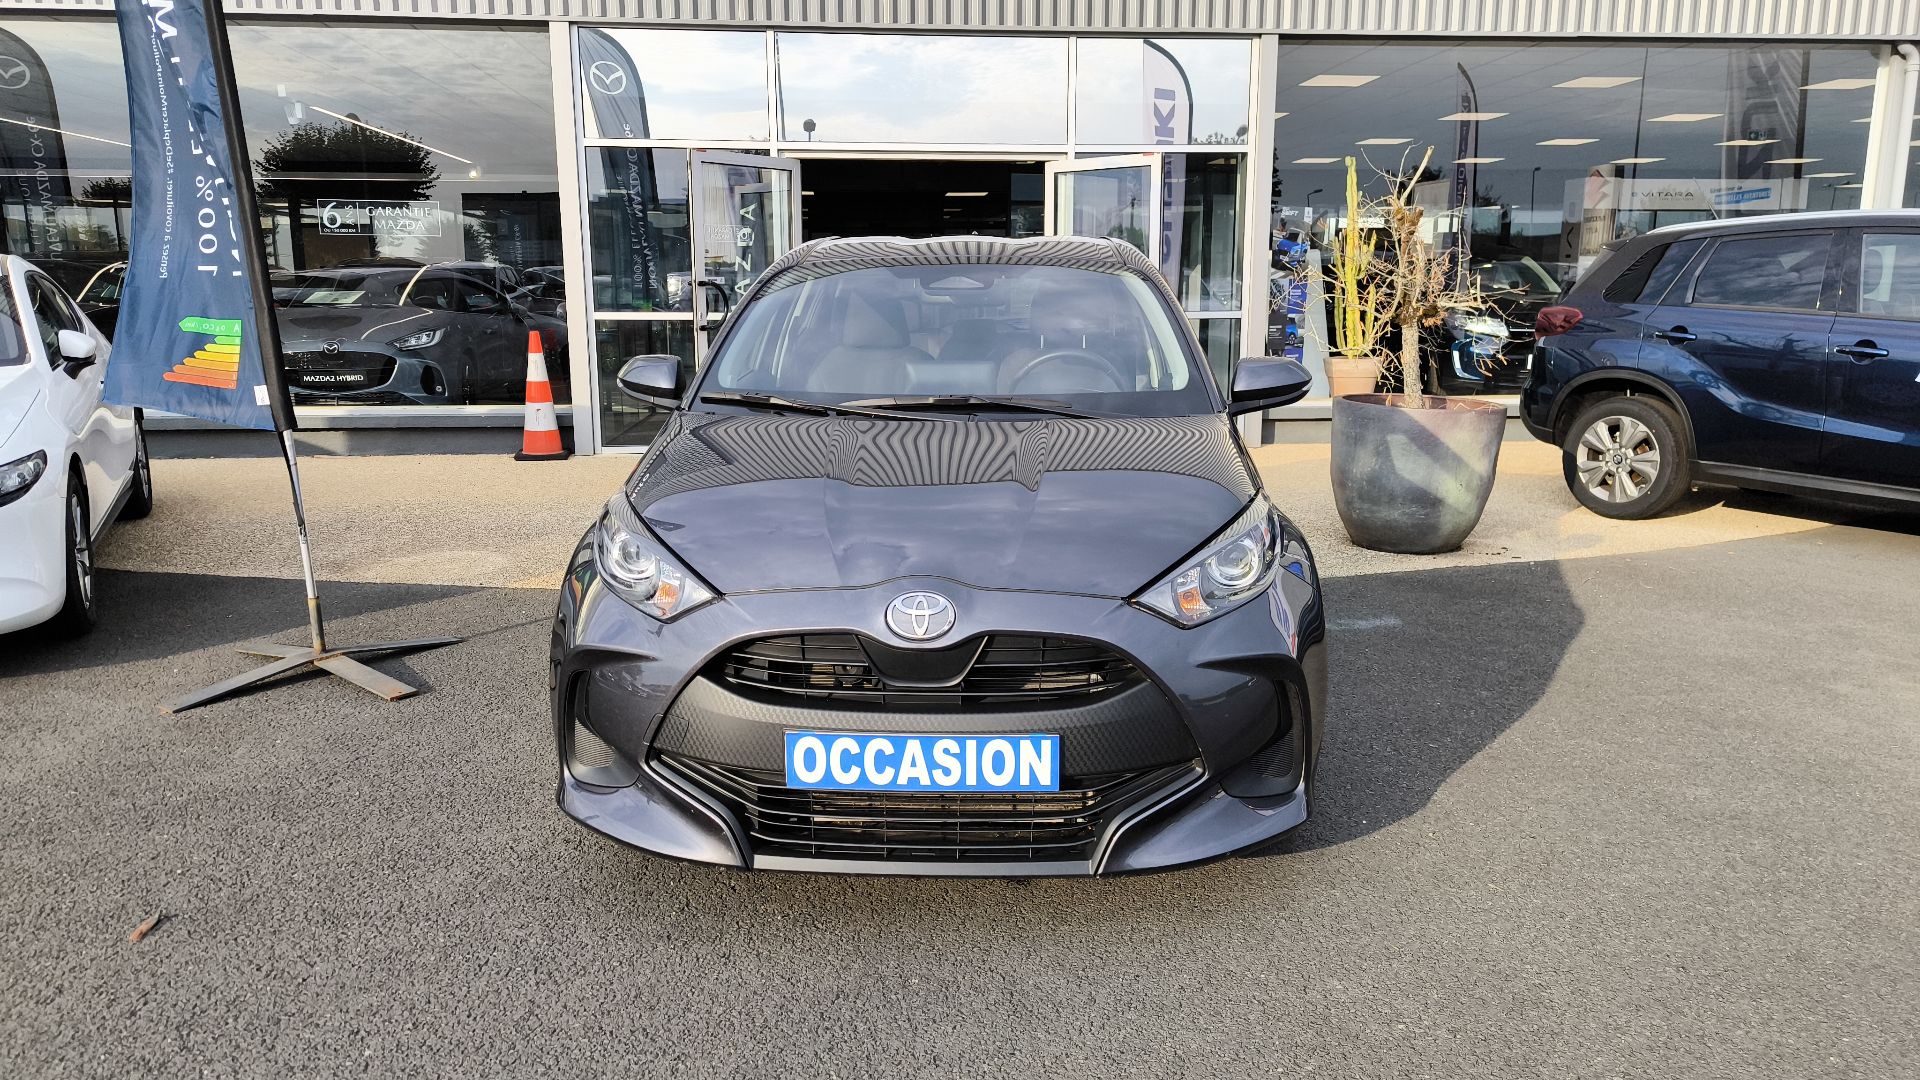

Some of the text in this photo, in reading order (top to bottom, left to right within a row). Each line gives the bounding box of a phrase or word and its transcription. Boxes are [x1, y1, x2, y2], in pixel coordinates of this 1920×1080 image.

[322, 201, 342, 229] 6
[344, 204, 355, 226] ANS
[365, 206, 432, 217] GARANTIE
[374, 219, 426, 230] MAZDA
[731, 202, 758, 311] AZDA
[336, 374, 364, 382] HYBRID
[792, 735, 1052, 788] OCCASION
